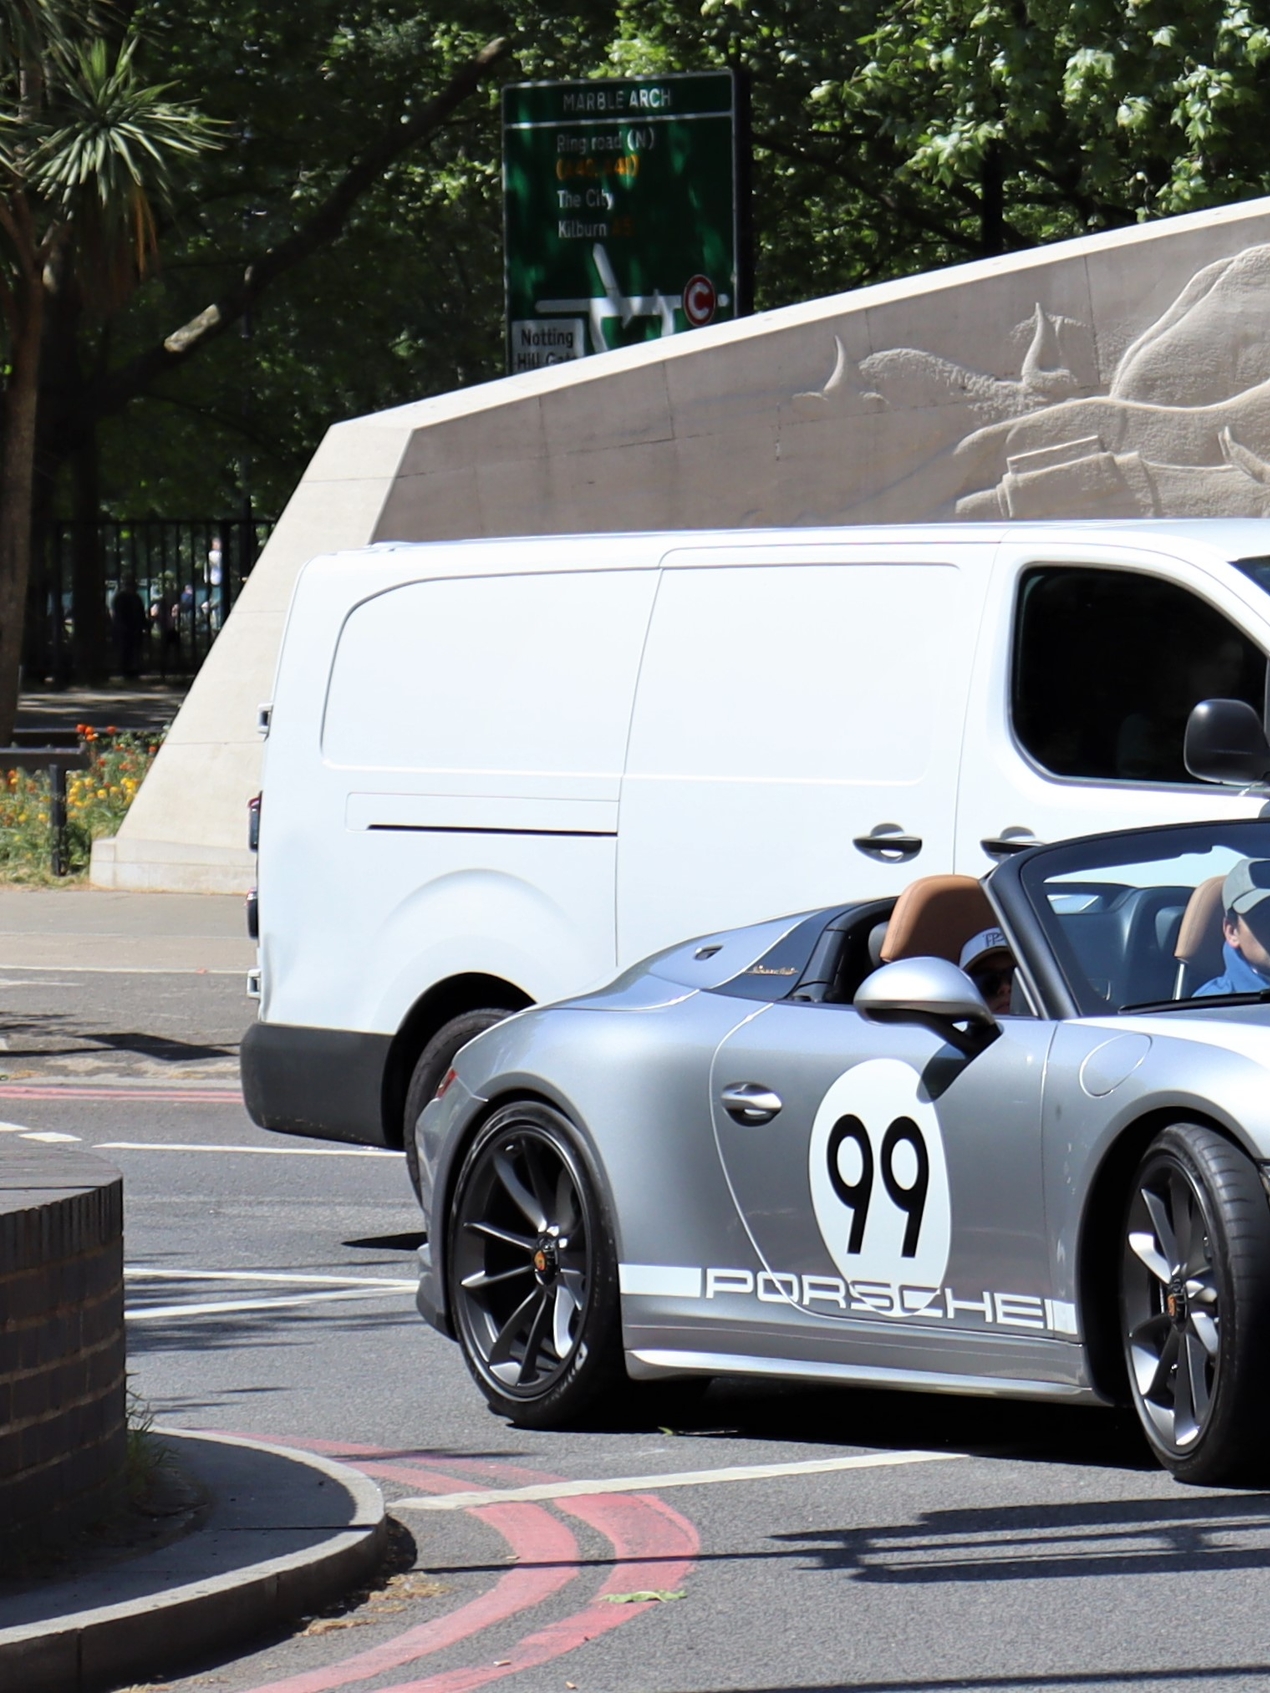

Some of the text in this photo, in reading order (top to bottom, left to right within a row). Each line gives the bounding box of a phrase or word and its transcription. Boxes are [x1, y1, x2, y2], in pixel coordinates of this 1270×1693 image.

[563, 87, 671, 112] MARBLE ARCH
[556, 126, 655, 155] Ring road (N)
[557, 188, 613, 211] The City
[558, 220, 607, 238] Kilburn
[521, 328, 574, 349] Notting
[517, 352, 540, 370] Hill
[826, 1113, 930, 1259] 99
[705, 1268, 1045, 1330] PORSCHE
